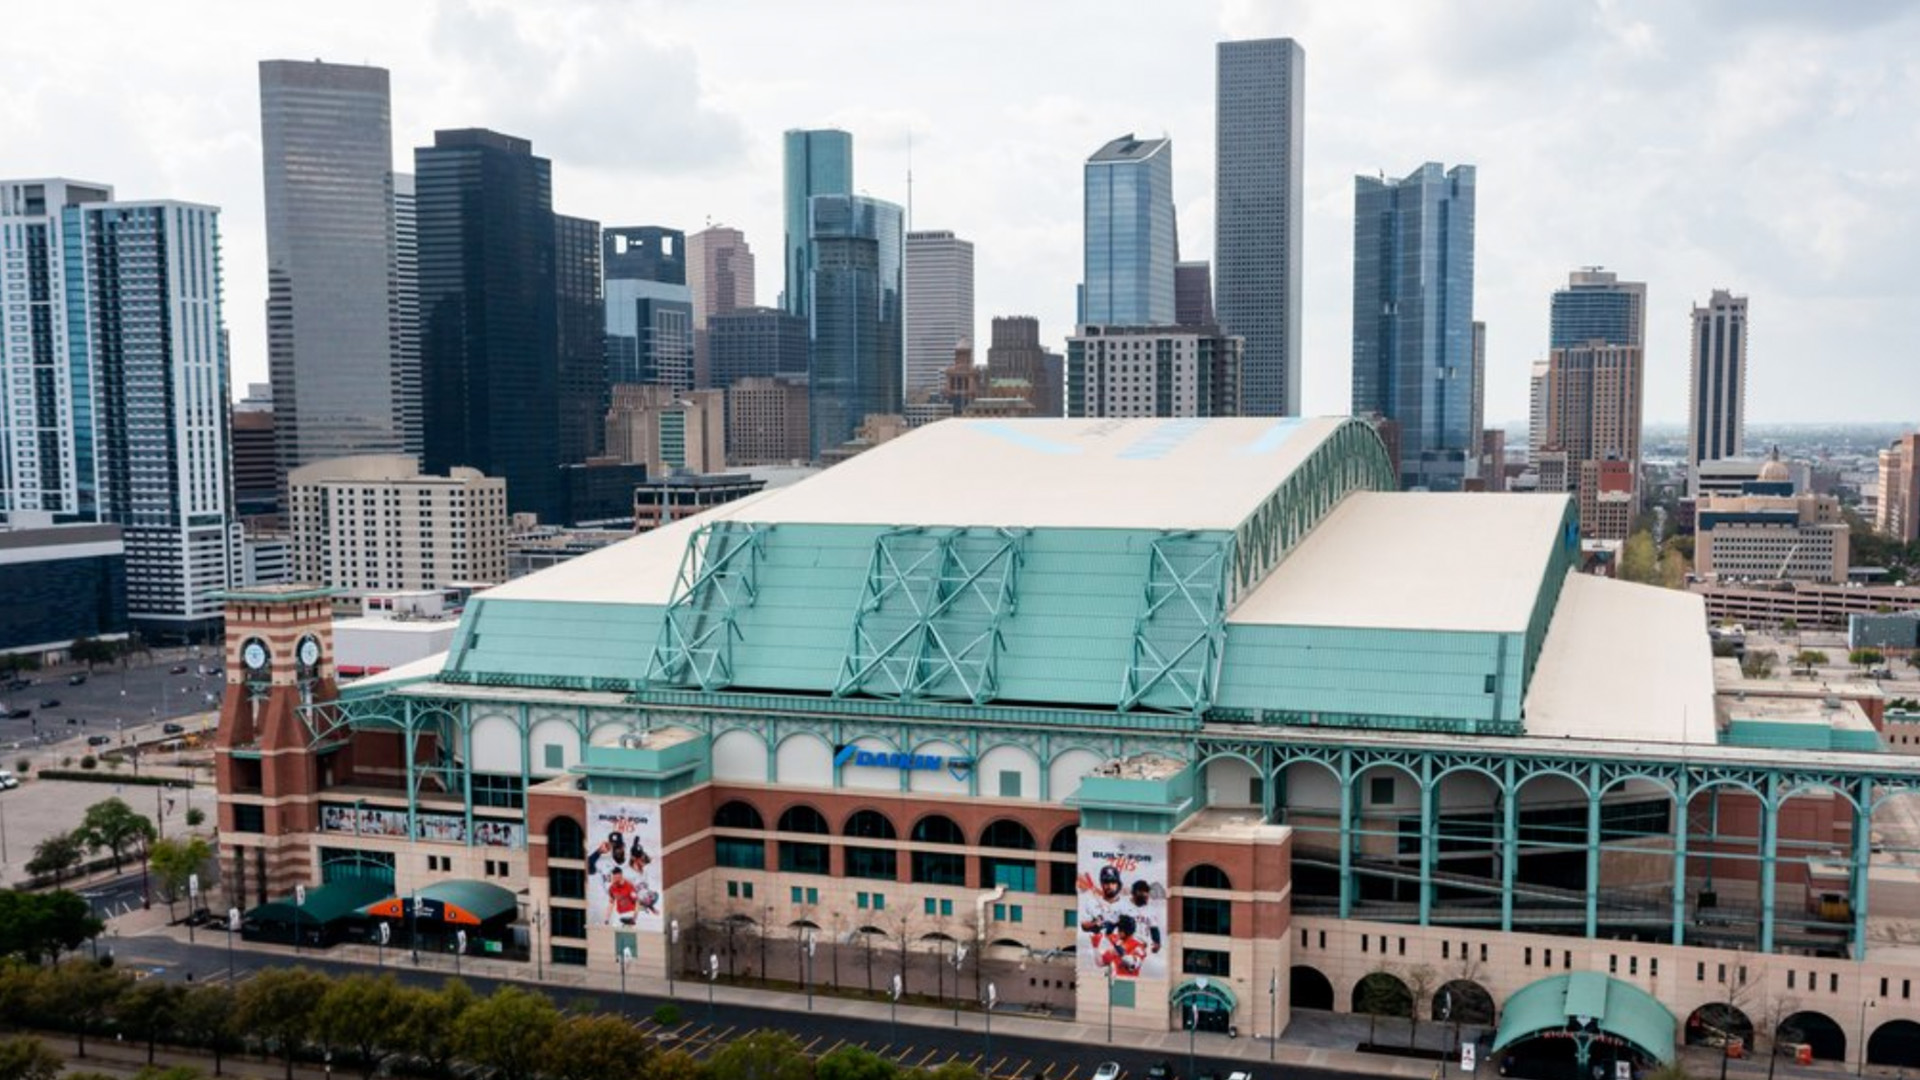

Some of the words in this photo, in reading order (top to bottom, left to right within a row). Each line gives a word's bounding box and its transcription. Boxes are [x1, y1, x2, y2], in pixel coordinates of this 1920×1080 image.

[856, 751, 942, 771] DAIKIN
[628, 816, 648, 825] FOR
[1092, 851, 1124, 860] BUILT
[1128, 853, 1152, 862] FOR
